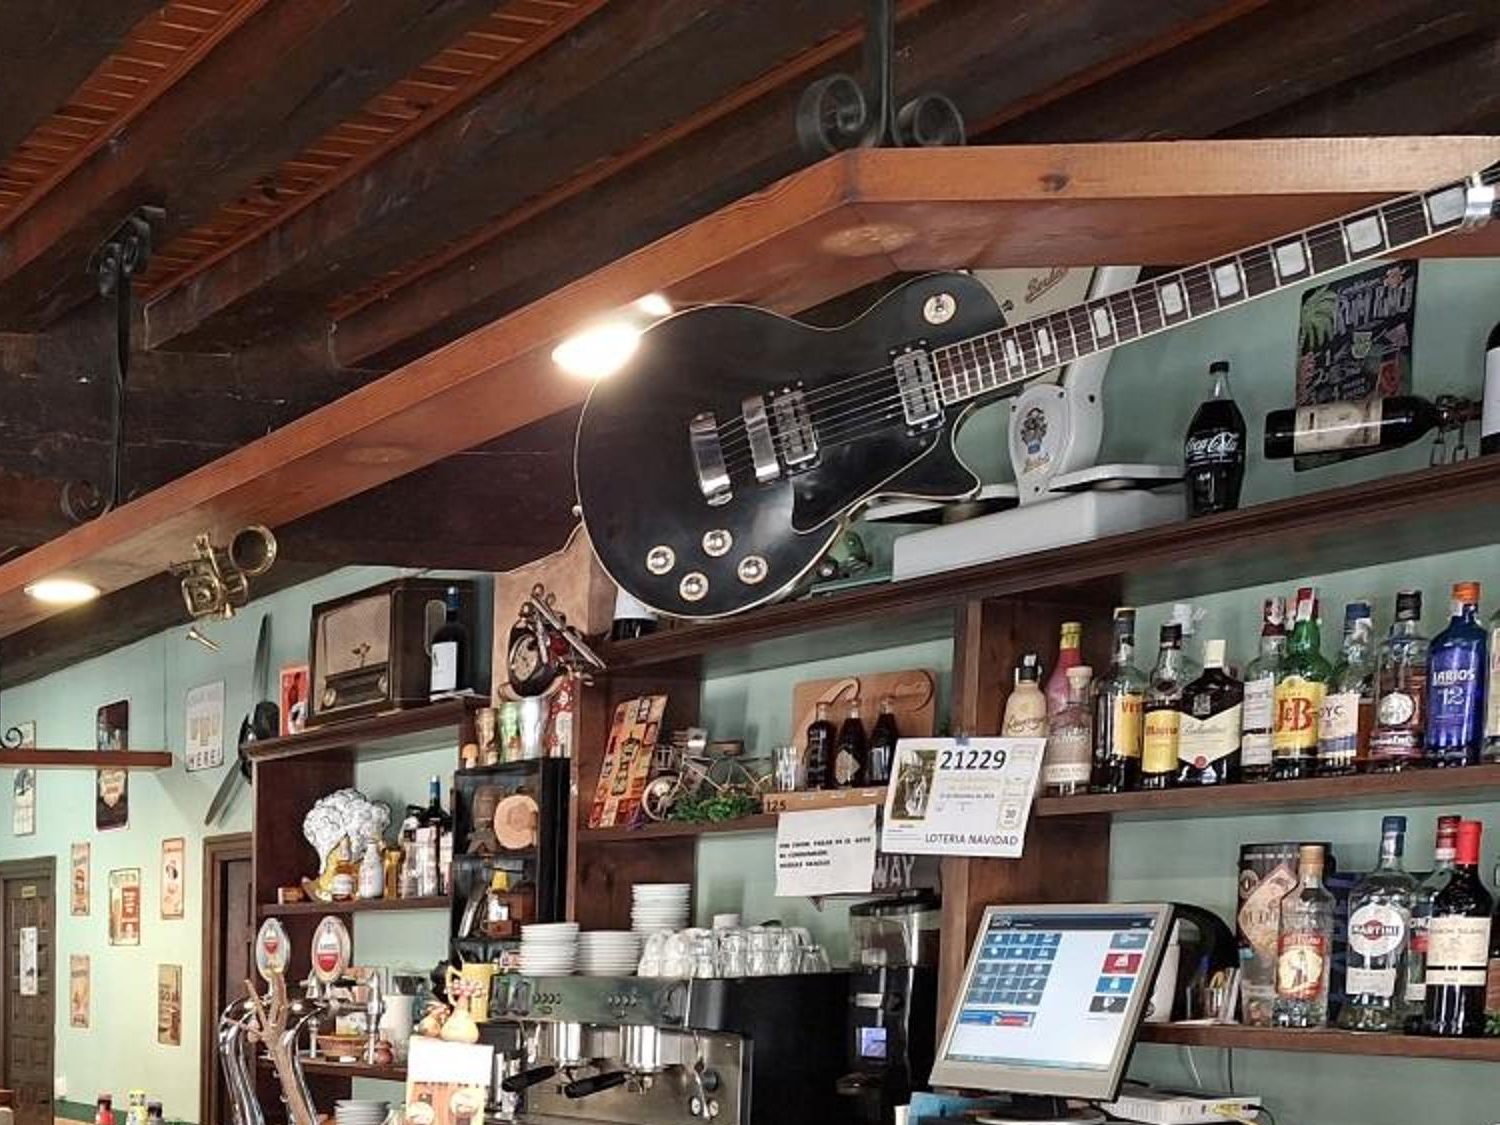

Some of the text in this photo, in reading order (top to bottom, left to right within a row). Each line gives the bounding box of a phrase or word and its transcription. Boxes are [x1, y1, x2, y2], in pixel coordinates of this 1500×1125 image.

[1432, 669, 1476, 686] LARIOS
[1275, 698, 1313, 732] J&B
[940, 750, 1007, 771] 21229
[766, 799, 787, 812] 125
[925, 833, 1019, 846] LOTERIA NAVIDAD
[1352, 924, 1400, 936] MARTINI
